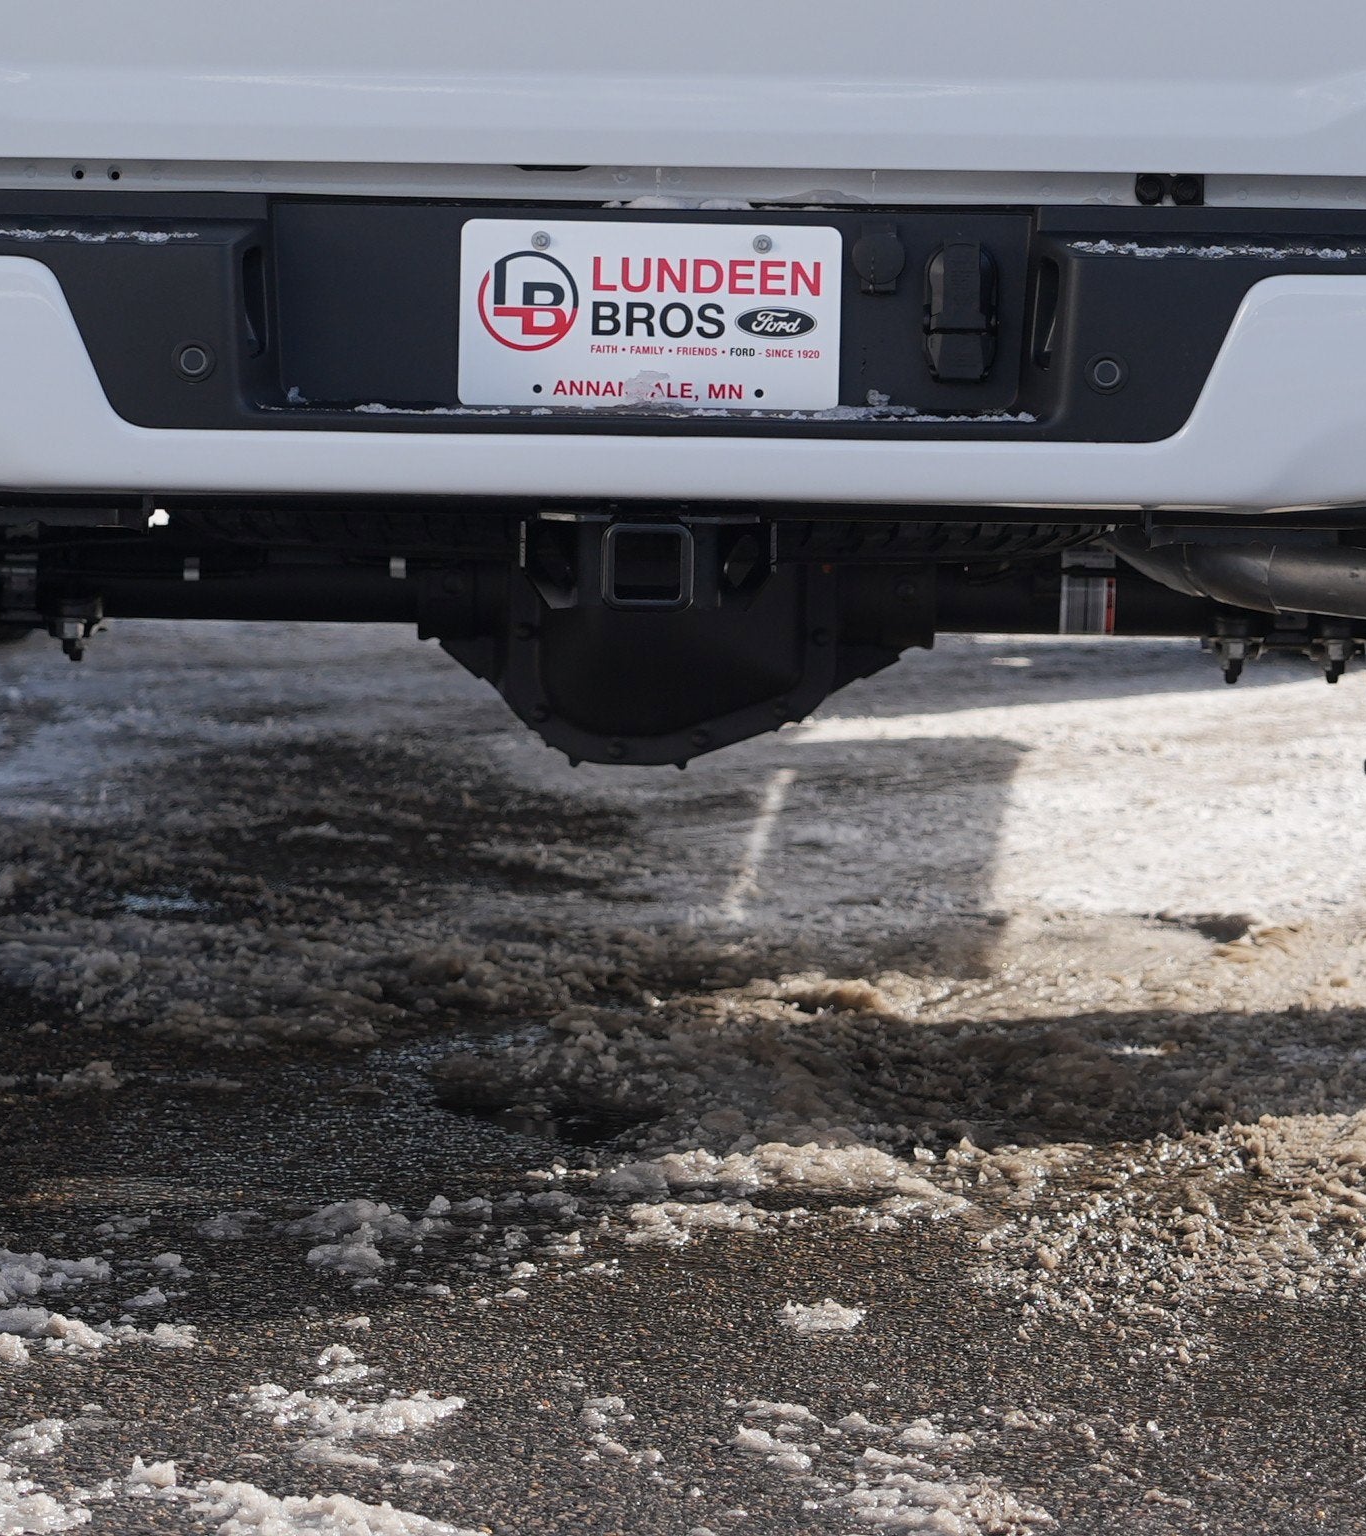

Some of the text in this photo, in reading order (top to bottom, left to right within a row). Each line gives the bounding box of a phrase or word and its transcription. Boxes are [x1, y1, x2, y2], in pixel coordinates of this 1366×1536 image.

[591, 256, 822, 297] LUNDEEN
[590, 301, 726, 340] BROS
[589, 344, 821, 360] FAITH FAMILY FRIENDS FORD SINCE 1920
[552, 379, 744, 402] ANNAALE, MN
